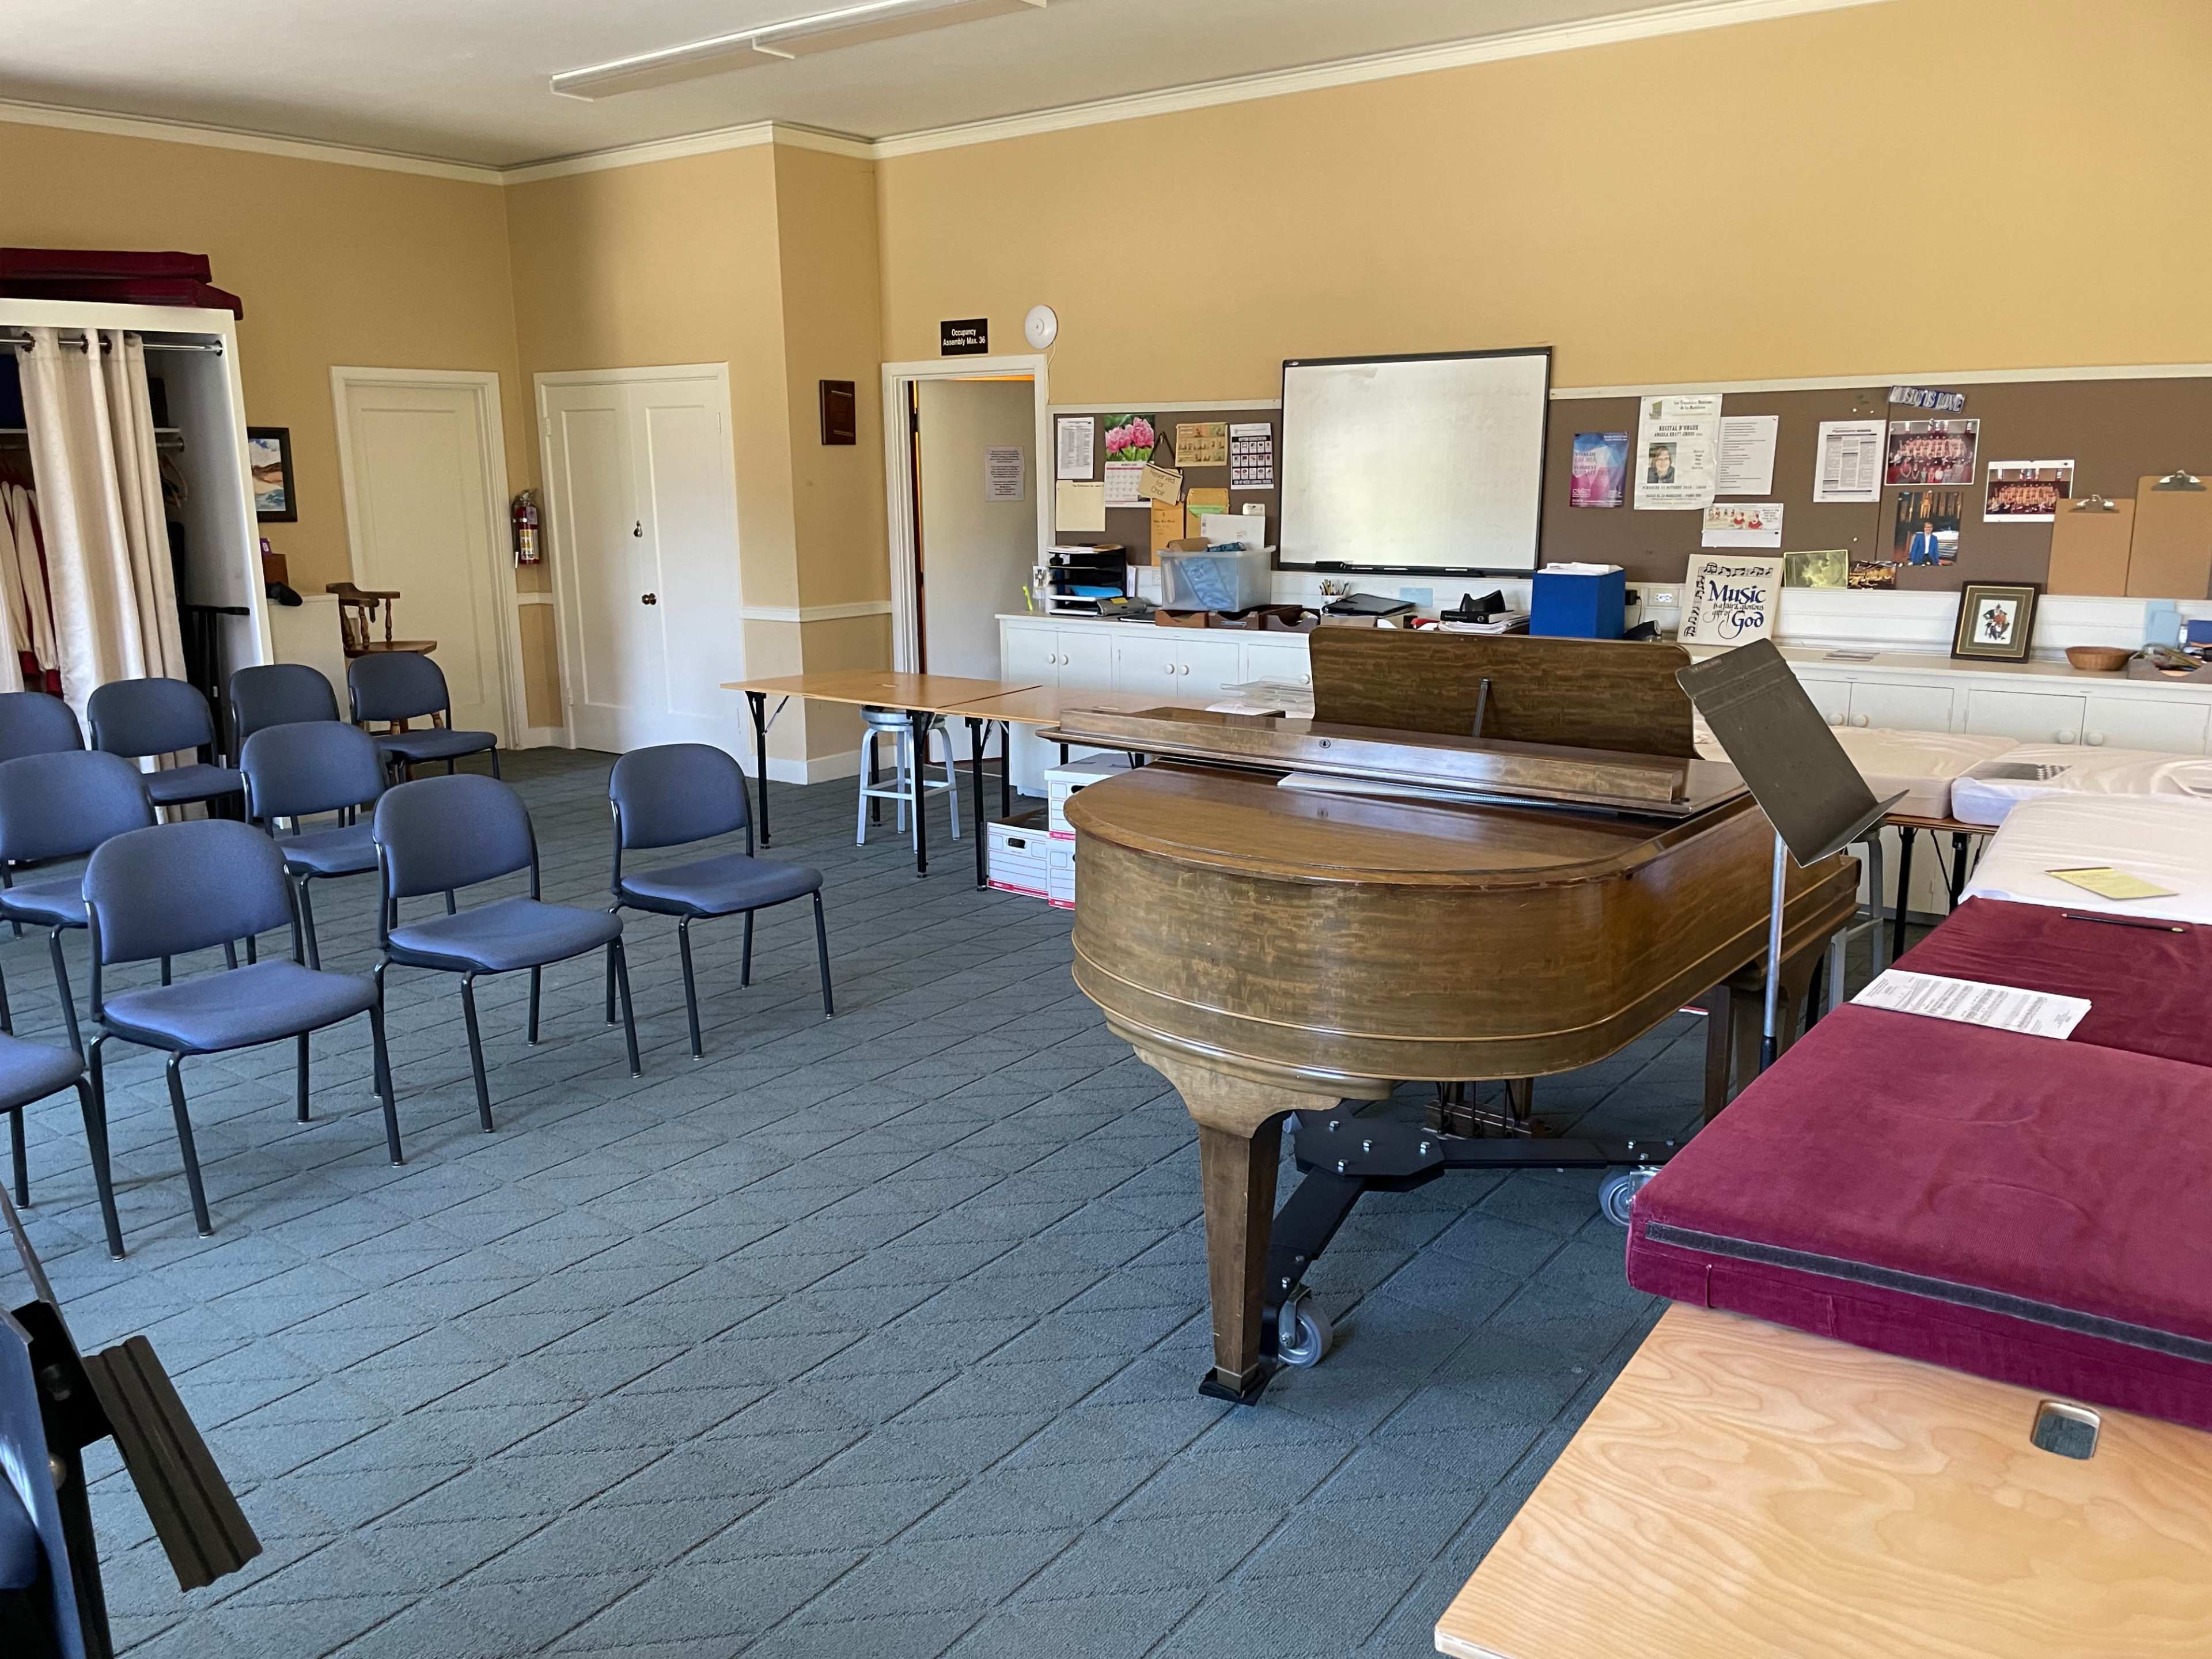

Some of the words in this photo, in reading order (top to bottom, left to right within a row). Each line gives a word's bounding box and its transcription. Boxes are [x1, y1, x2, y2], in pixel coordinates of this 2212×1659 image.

[951, 328, 976, 337] Occupancy
[943, 338, 965, 346] Assembly
[967, 336, 978, 344] Max.
[979, 336, 986, 344] 36
[1936, 392, 1963, 411] LOVE
[1151, 486, 1165, 496] Choir
[1707, 580, 1766, 604] Music
[1740, 603, 1764, 611] glorious
[1718, 611, 1764, 639] God
